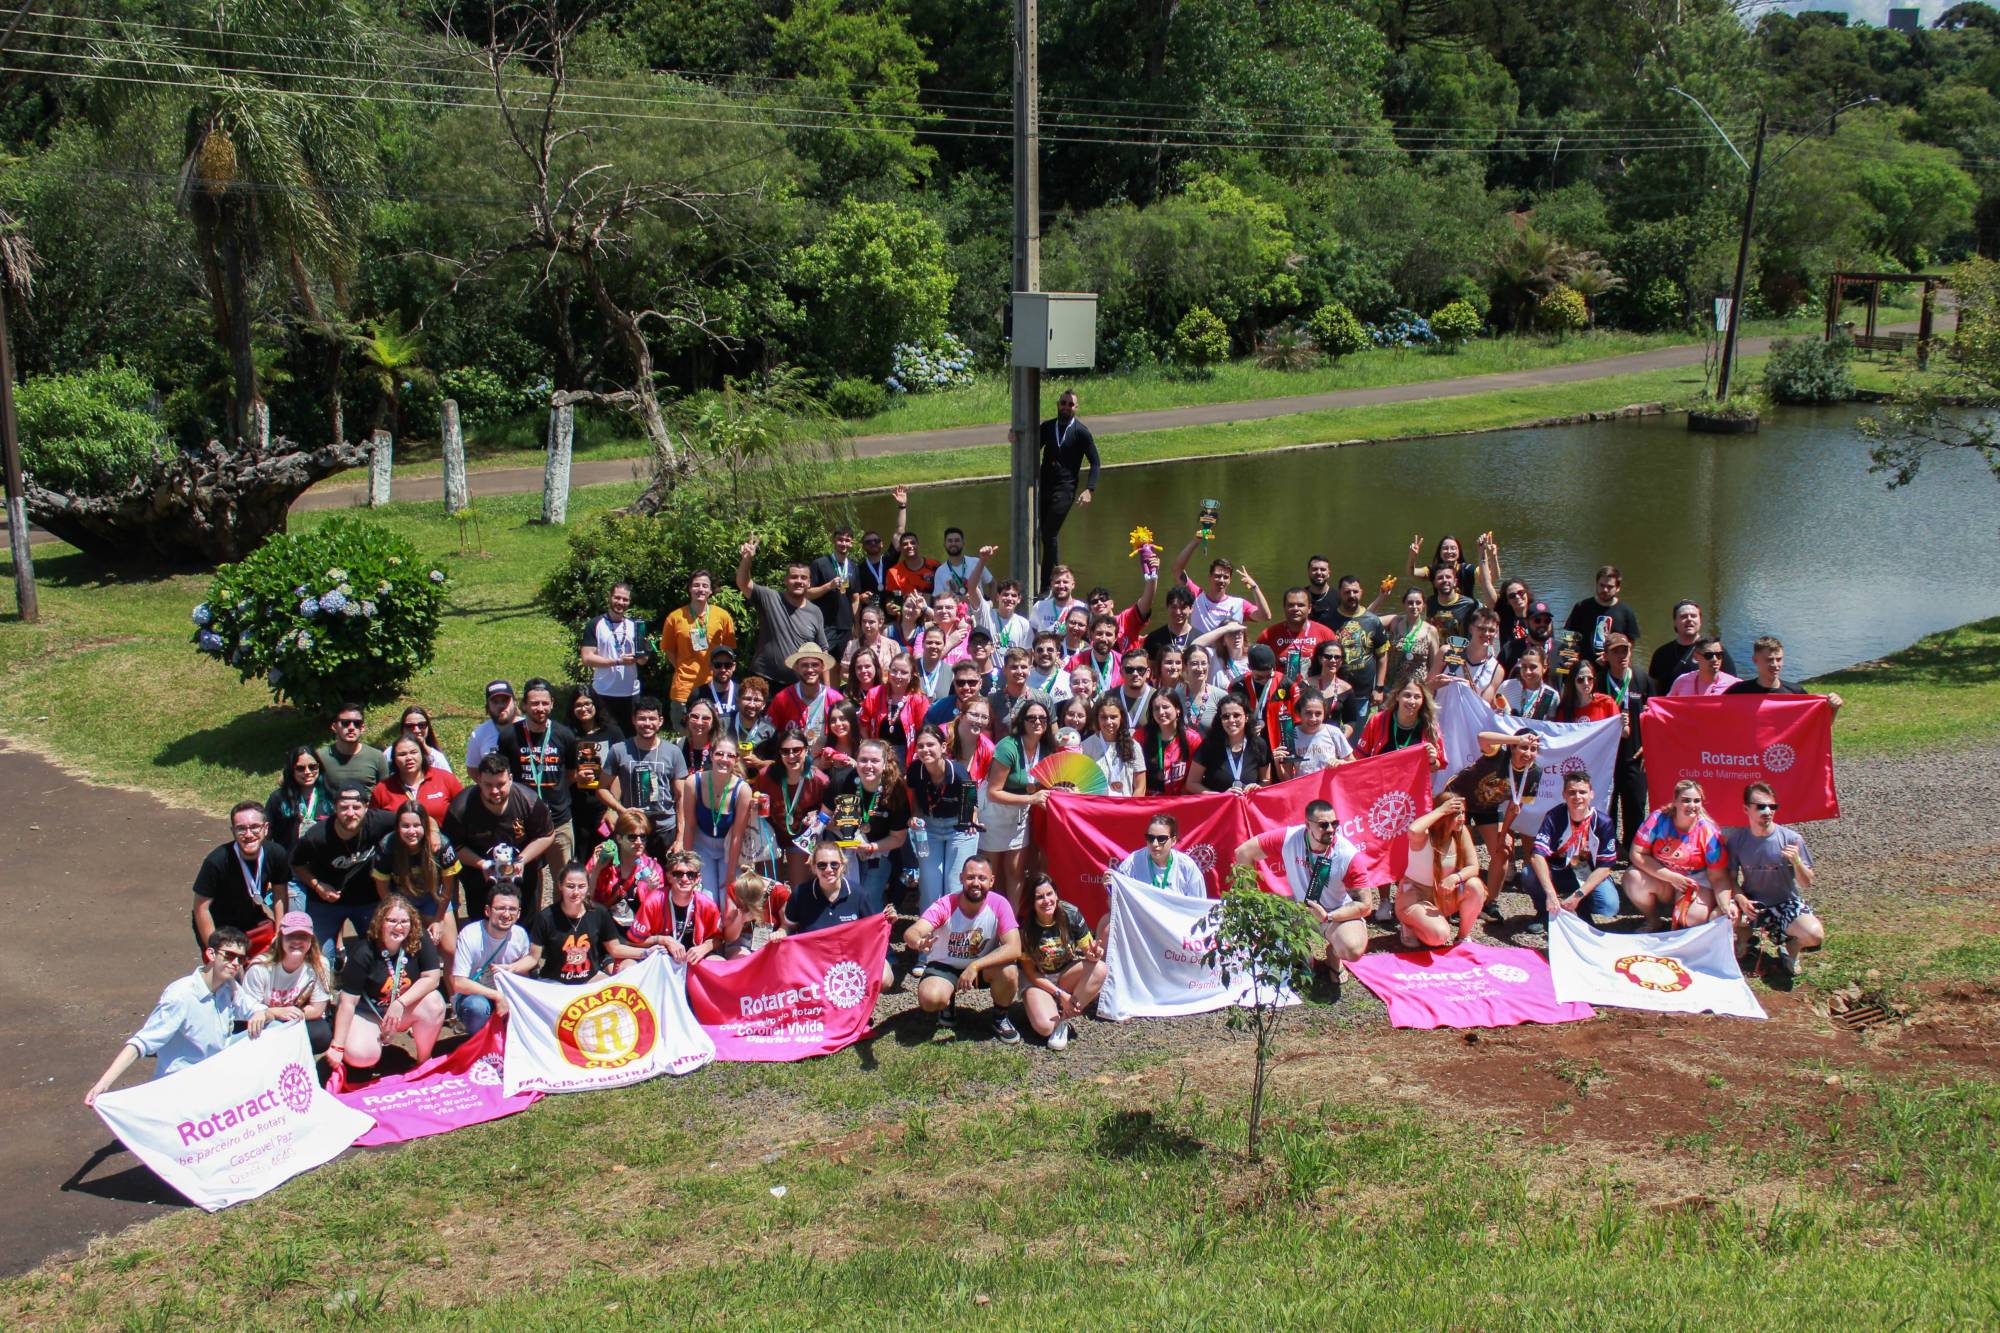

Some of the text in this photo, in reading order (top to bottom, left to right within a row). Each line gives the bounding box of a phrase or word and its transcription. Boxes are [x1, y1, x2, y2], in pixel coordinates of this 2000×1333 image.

[1701, 752, 1760, 766] Rotaract
[1679, 769, 1762, 780] Club de Marmeleiro
[1164, 950, 1187, 962] Club
[1616, 956, 1685, 974] ROTARACT
[1393, 967, 1484, 980] Rotaract
[1640, 981, 1684, 992] CLUB
[740, 982, 821, 1017] Rotaract
[561, 987, 646, 1032] ROTARACT
[792, 1006, 822, 1018] Rotary
[584, 1009, 629, 1055] R
[787, 1020, 824, 1036] Vivida
[746, 1035, 823, 1043] Distrito 4640
[584, 1051, 641, 1069] CLUB
[362, 1078, 469, 1107] Rotaract
[176, 1089, 280, 1147] Rotaract
[197, 1136, 241, 1164] parceiro
[242, 1127, 256, 1141] do
[257, 1114, 287, 1134] Rotary
[229, 1137, 275, 1168] Cascavel
